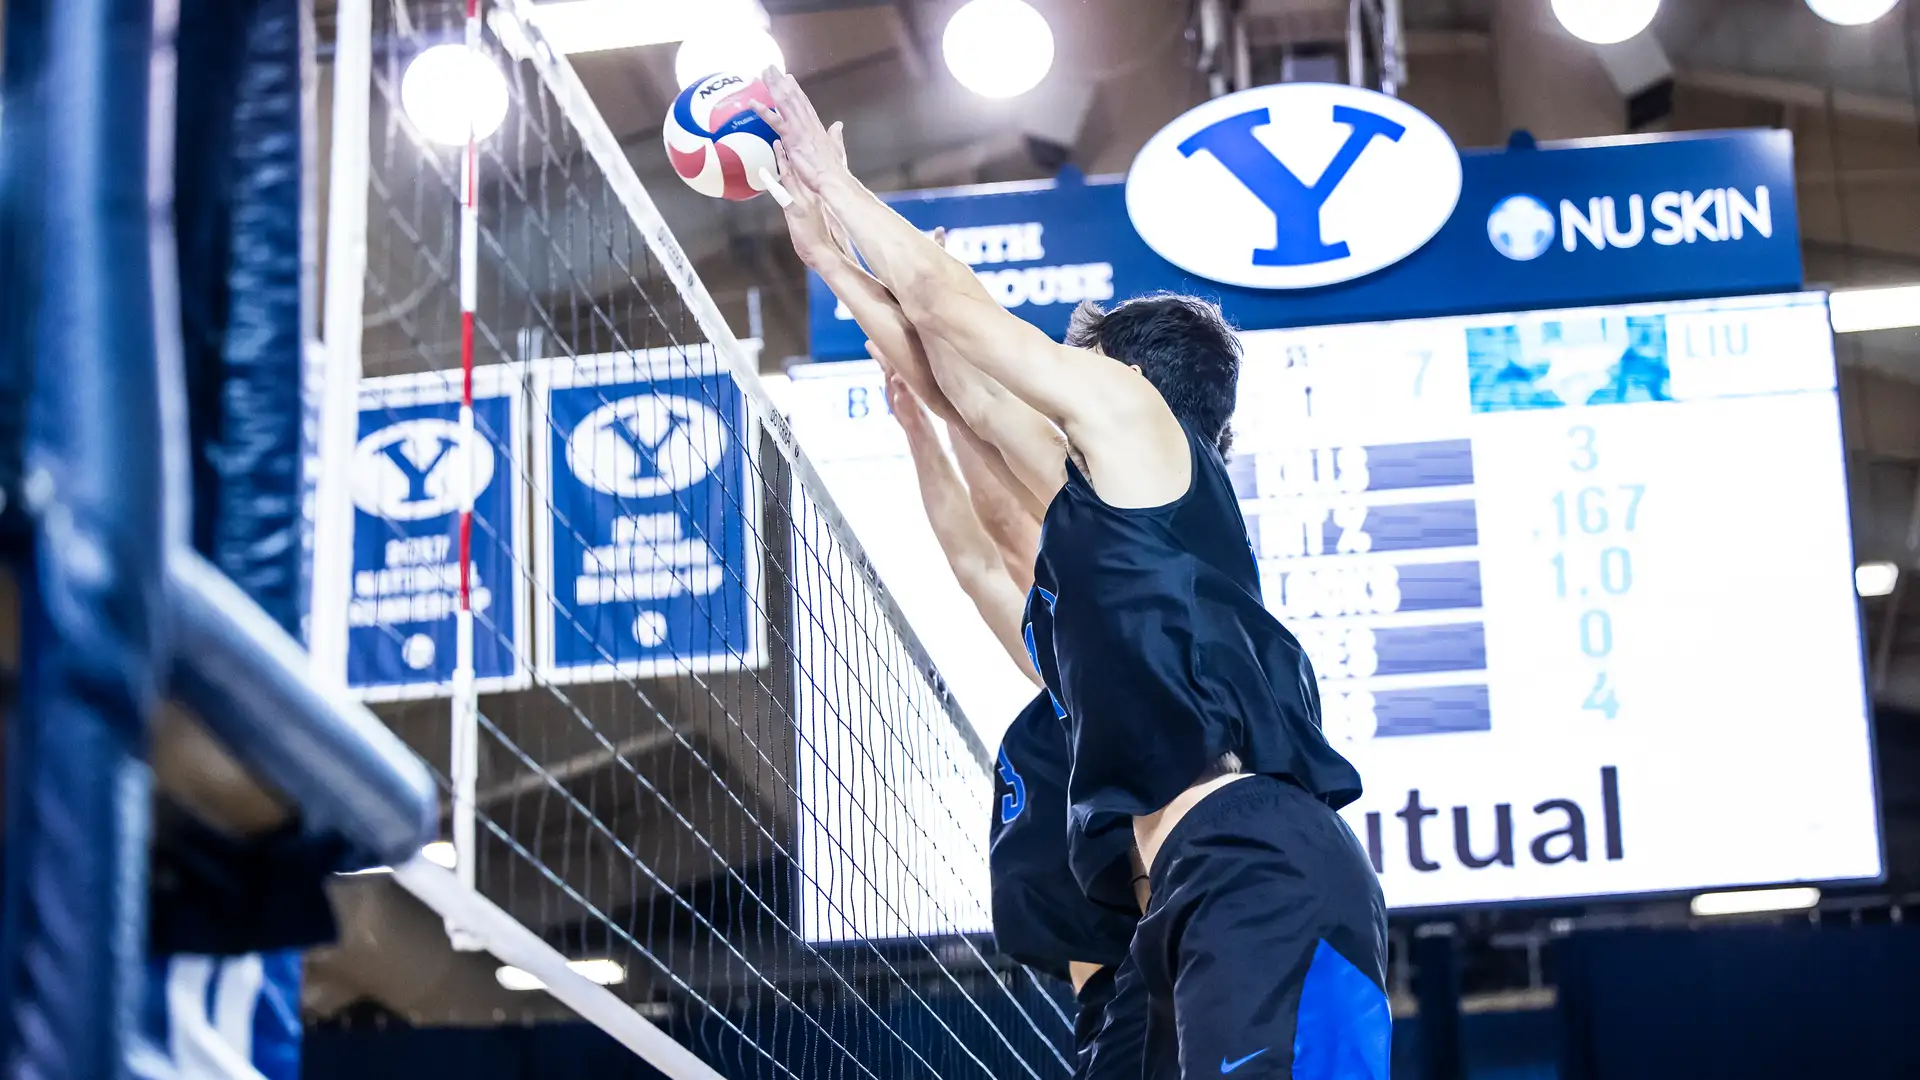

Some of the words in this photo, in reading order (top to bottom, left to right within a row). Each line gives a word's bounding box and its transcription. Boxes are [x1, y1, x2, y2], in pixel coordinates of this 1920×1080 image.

[1177, 104, 1406, 266] Y
[1560, 193, 1646, 252] NU
[1651, 185, 1773, 246] SKIN
[1684, 323, 1750, 358] LIU
[1404, 350, 1433, 398] 7
[374, 436, 459, 503] Y
[601, 412, 691, 480] Y
[1567, 425, 1599, 471] 3
[1531, 484, 1646, 541] .167
[1551, 547, 1633, 599] 1.0
[1580, 609, 1613, 658] 0
[1582, 672, 1620, 719] 4
